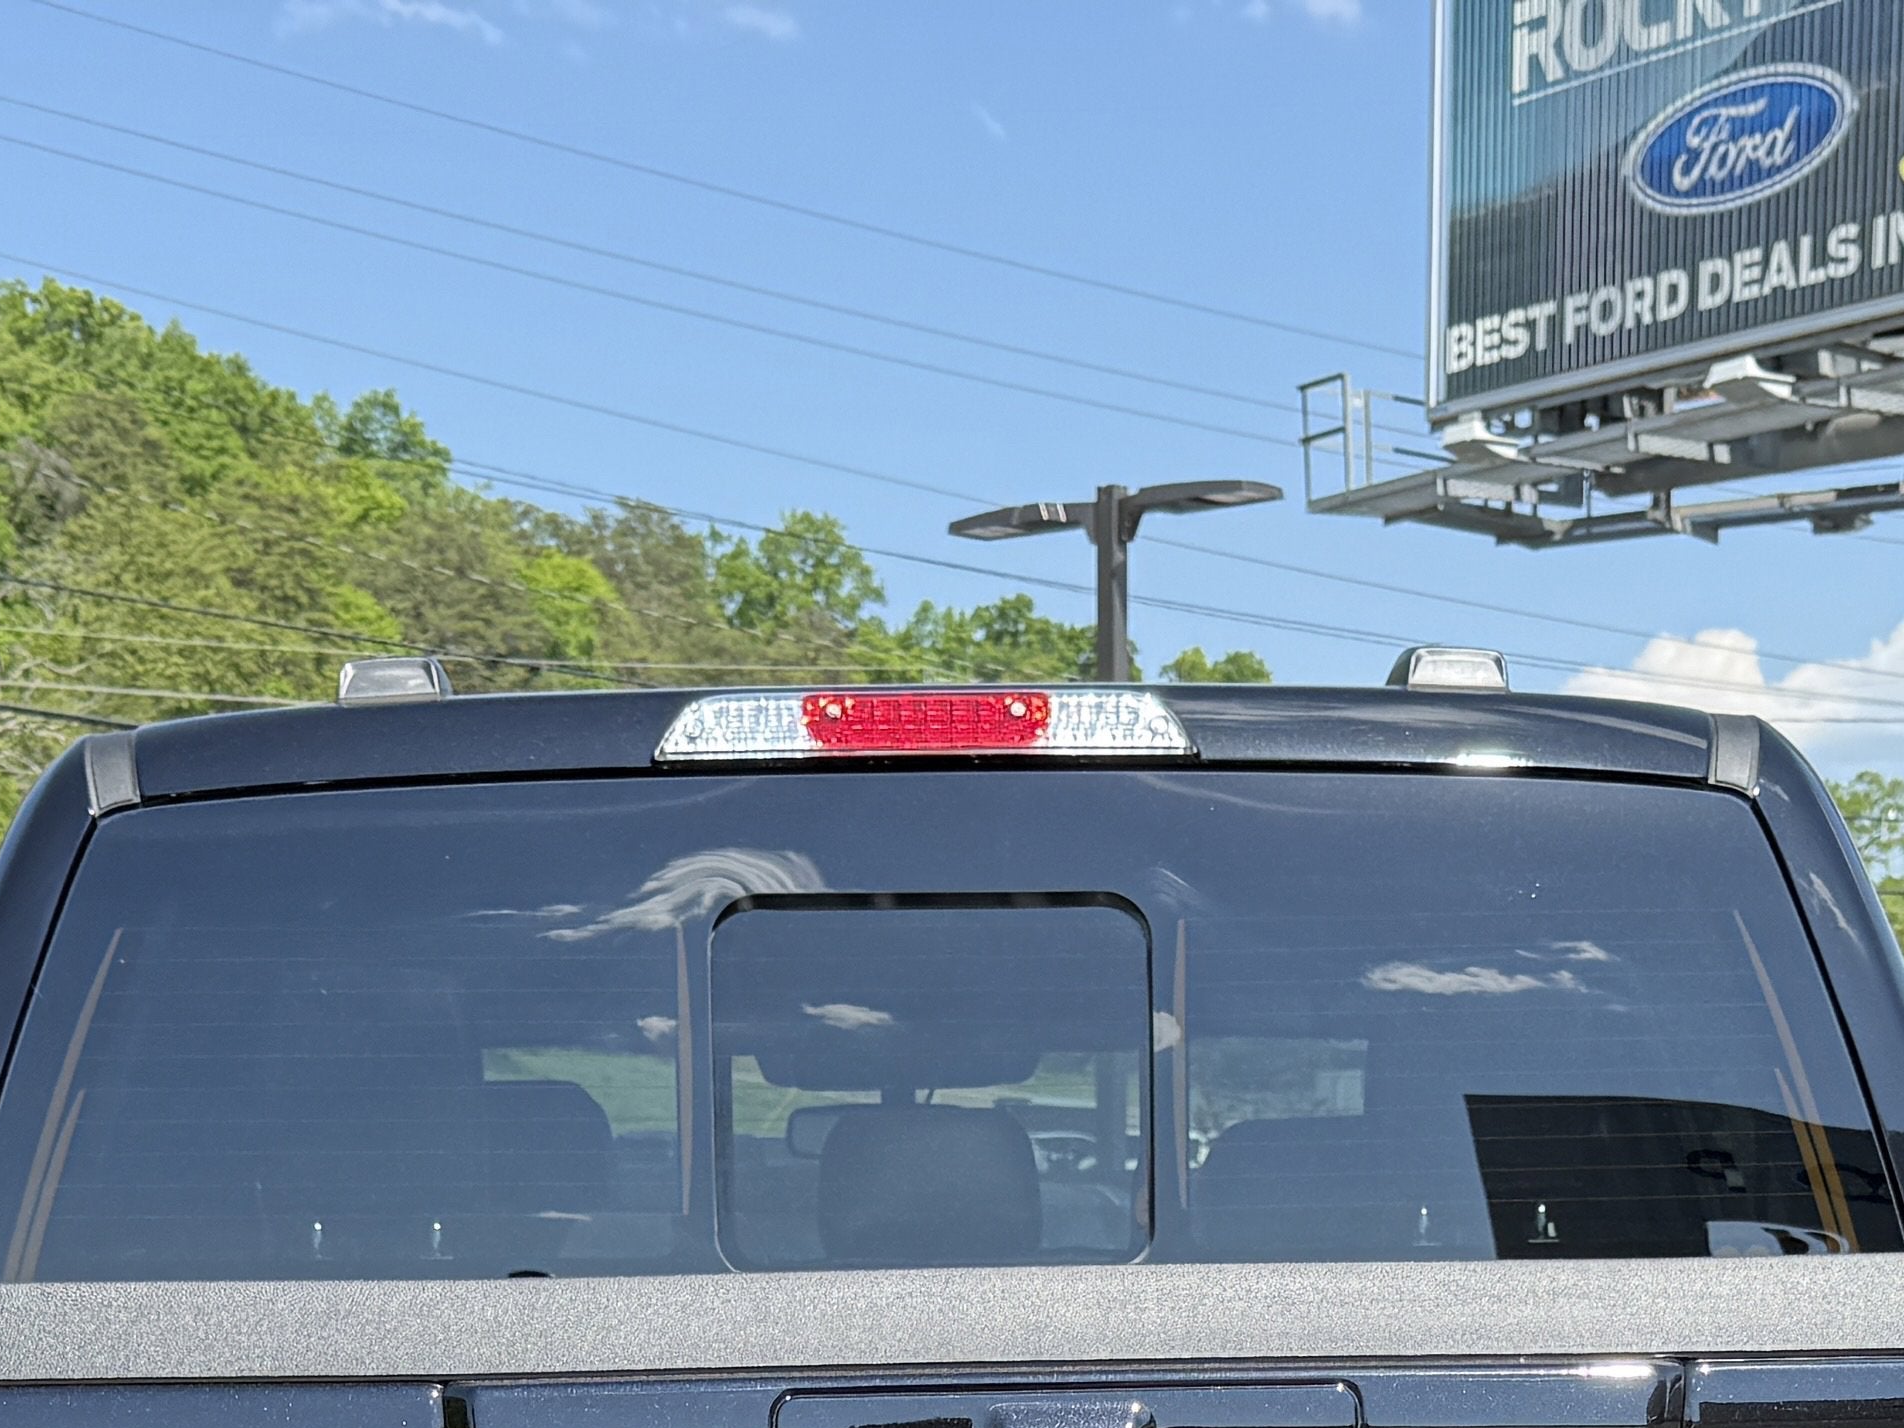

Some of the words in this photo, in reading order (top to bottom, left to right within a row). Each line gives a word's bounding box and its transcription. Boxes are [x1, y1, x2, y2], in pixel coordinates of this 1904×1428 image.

[1512, 0, 1762, 93] ROC
[1672, 97, 1802, 192] Ford
[1446, 299, 1557, 375] BEST
[1564, 268, 1690, 345] FORD
[1698, 222, 1862, 312] DEALS
